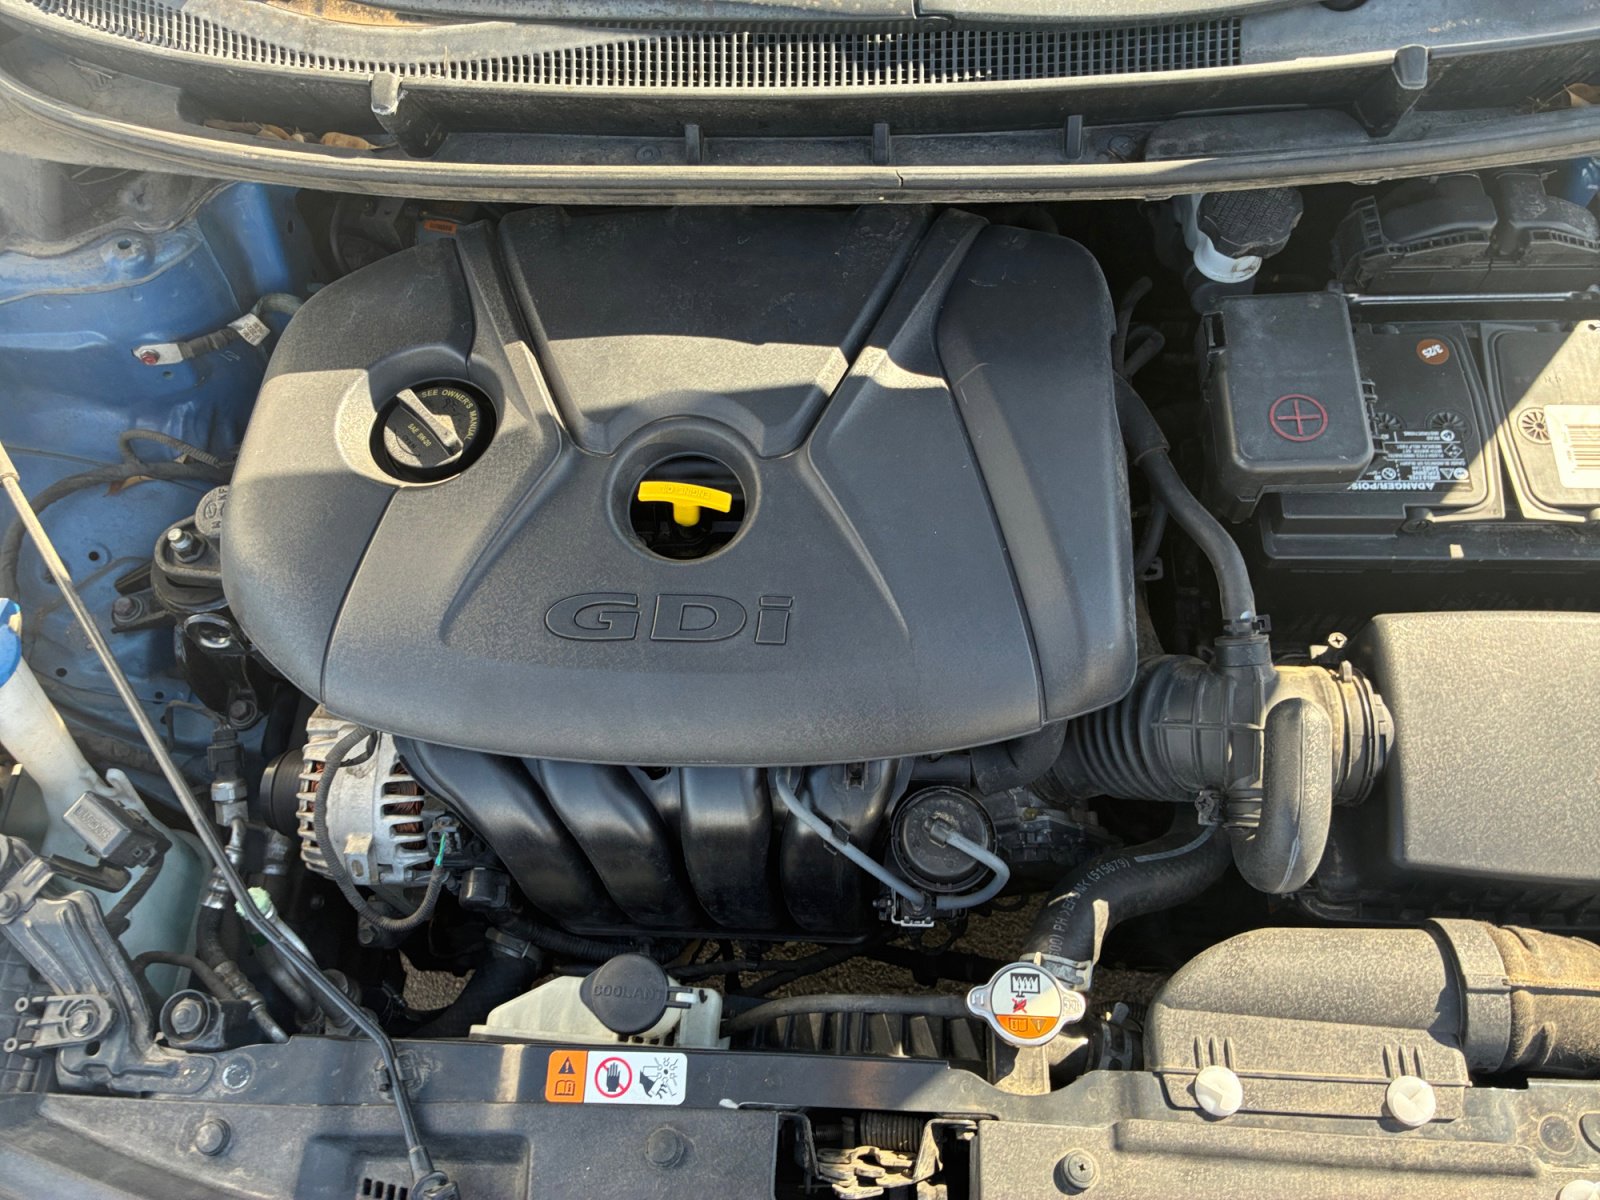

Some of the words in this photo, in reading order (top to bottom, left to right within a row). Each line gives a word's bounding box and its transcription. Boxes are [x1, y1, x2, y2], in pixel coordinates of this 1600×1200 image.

[421, 389, 439, 398] SEE
[441, 389, 474, 409] OWNER'S
[464, 410, 479, 440] MANUAL
[679, 486, 712, 499] ENGINE
[544, 592, 795, 645] GDi
[594, 984, 660, 1000] COOLANT
